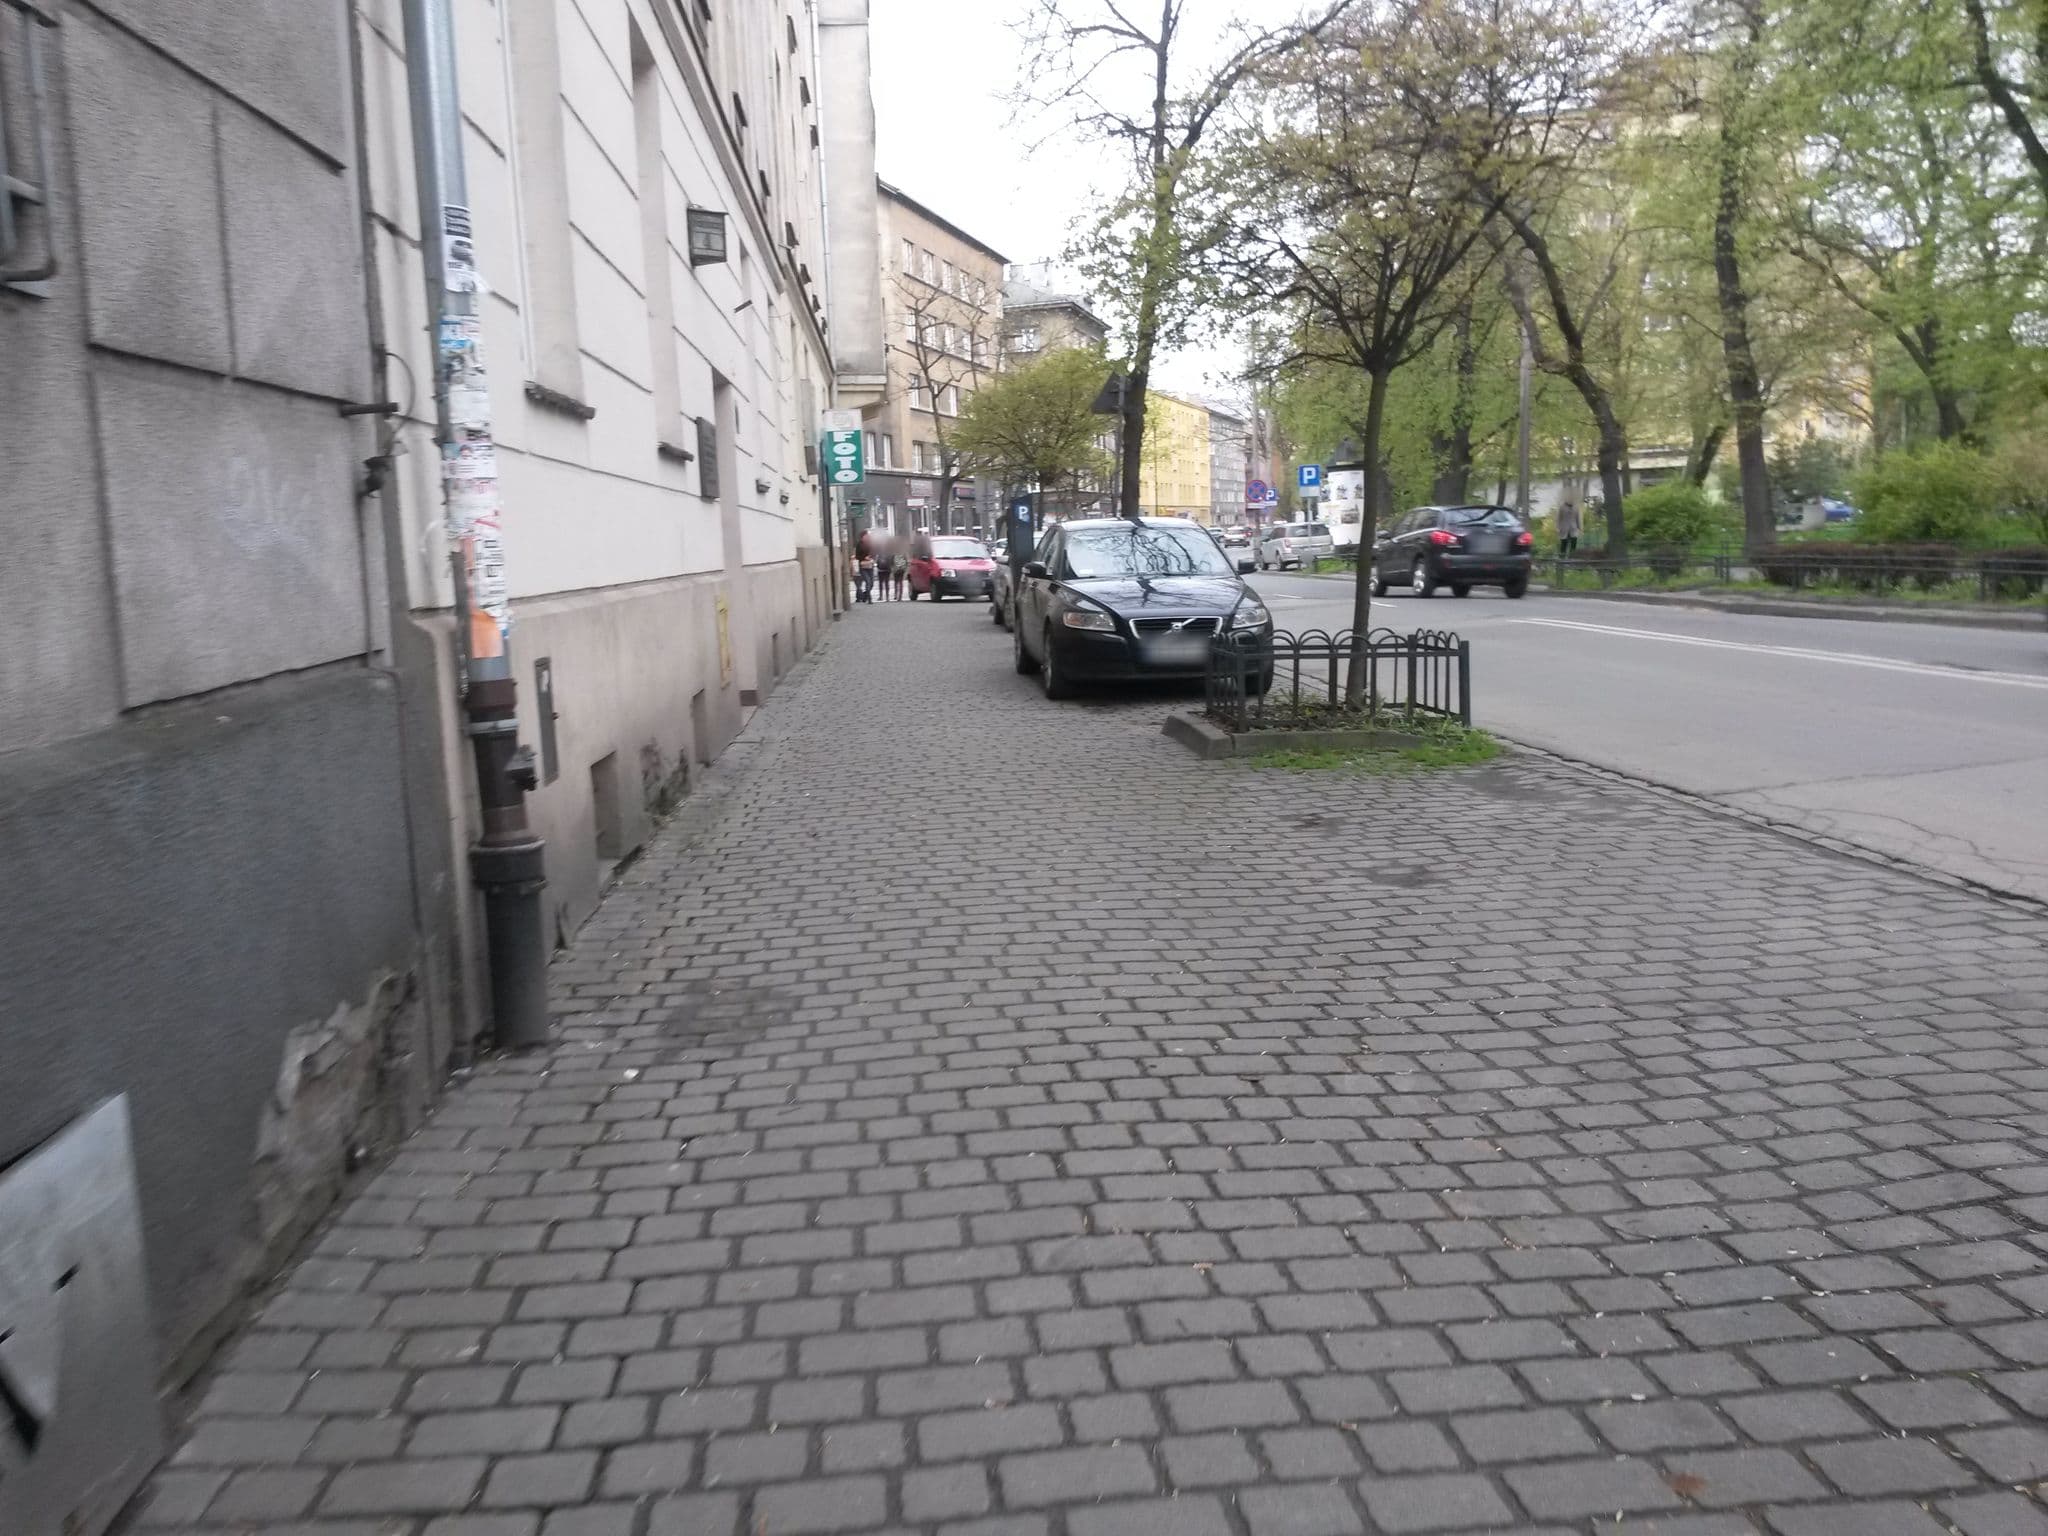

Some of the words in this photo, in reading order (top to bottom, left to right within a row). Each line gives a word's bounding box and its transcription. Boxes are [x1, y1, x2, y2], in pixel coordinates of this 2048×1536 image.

[833, 431, 858, 482] FOTO
[1303, 467, 1316, 485] P
[1266, 490, 1275, 500] P
[1018, 505, 1029, 520] P
